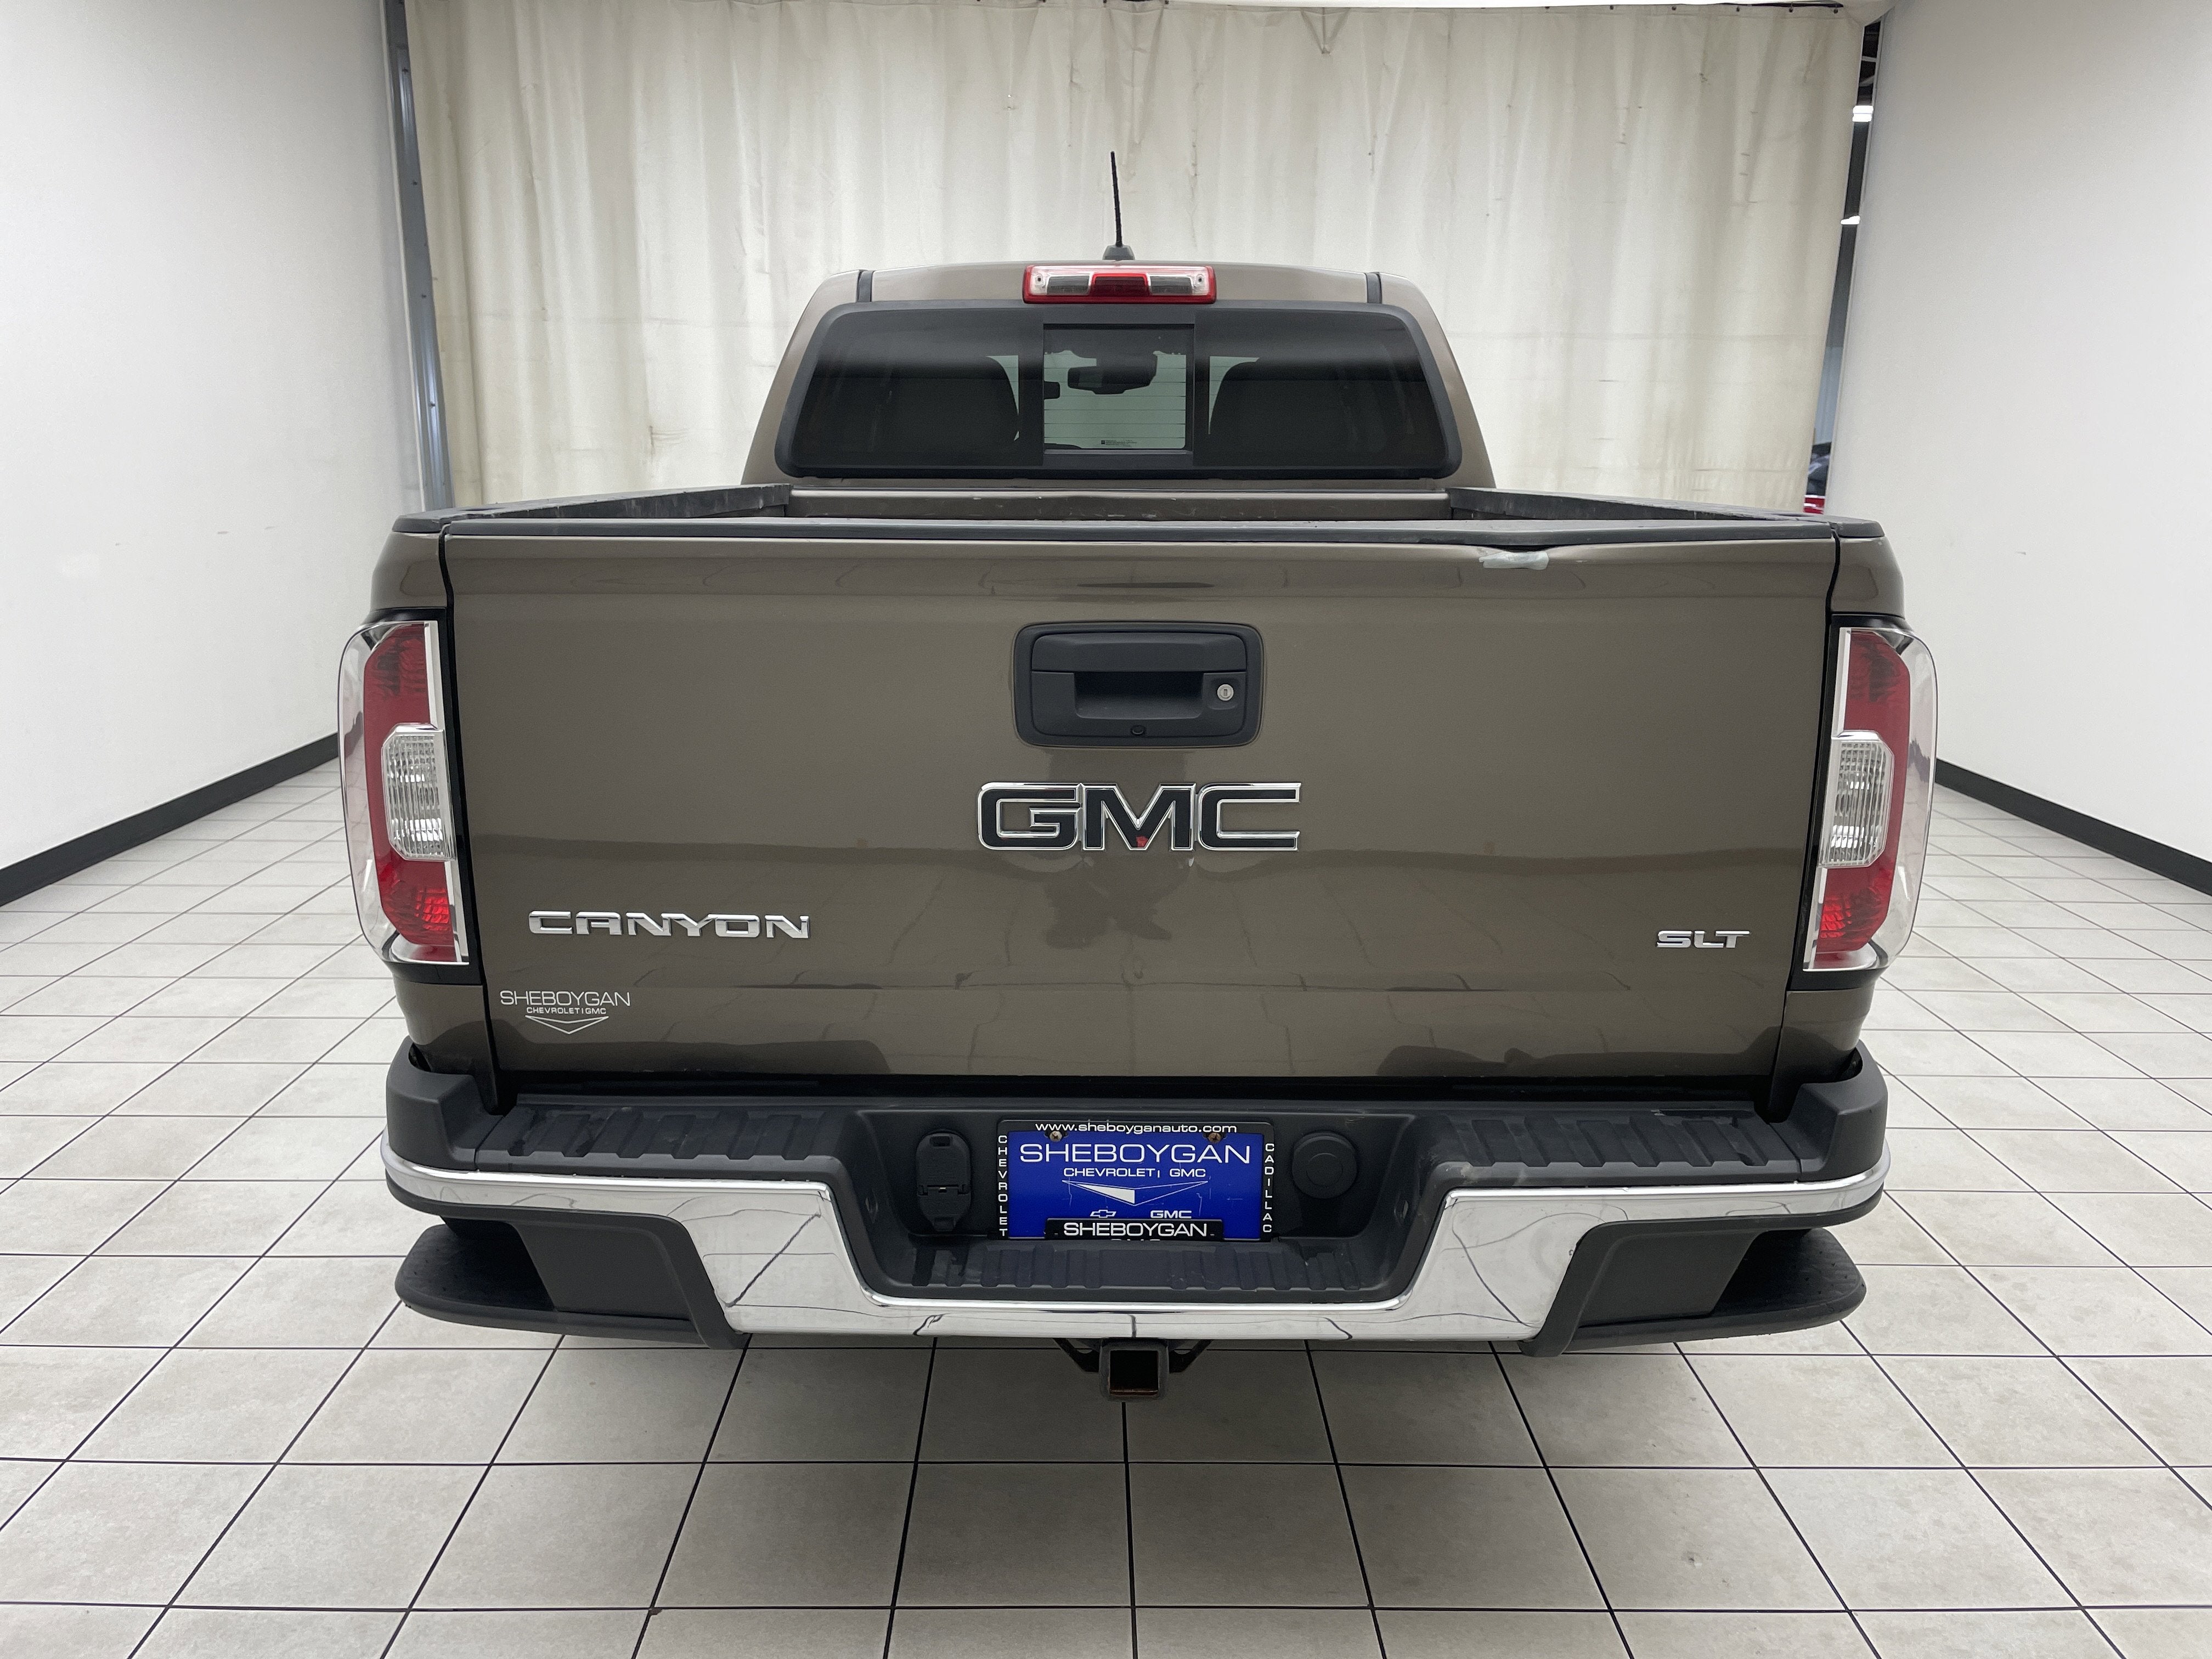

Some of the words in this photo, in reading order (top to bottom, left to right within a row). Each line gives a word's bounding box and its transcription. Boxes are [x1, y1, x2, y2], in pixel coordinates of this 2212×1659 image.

[977, 782, 1301, 851] GMC
[528, 910, 809, 939] CANYON
[1656, 930, 1751, 949] SLT
[500, 990, 631, 1007] SHEBOYGAN
[1035, 1122, 1237, 1135] www.sheboyganauto.com
[1020, 1143, 1250, 1164] SHEBOYGAN
[1063, 1167, 1156, 1177] CHEVROLET
[1169, 1167, 1206, 1178] GMC
[997, 1135, 1008, 1237] CHEVROLET
[1262, 1143, 1275, 1233] CADILLAC
[1150, 1210, 1193, 1219] GMC
[1063, 1222, 1207, 1237] SHEBOYGAN
